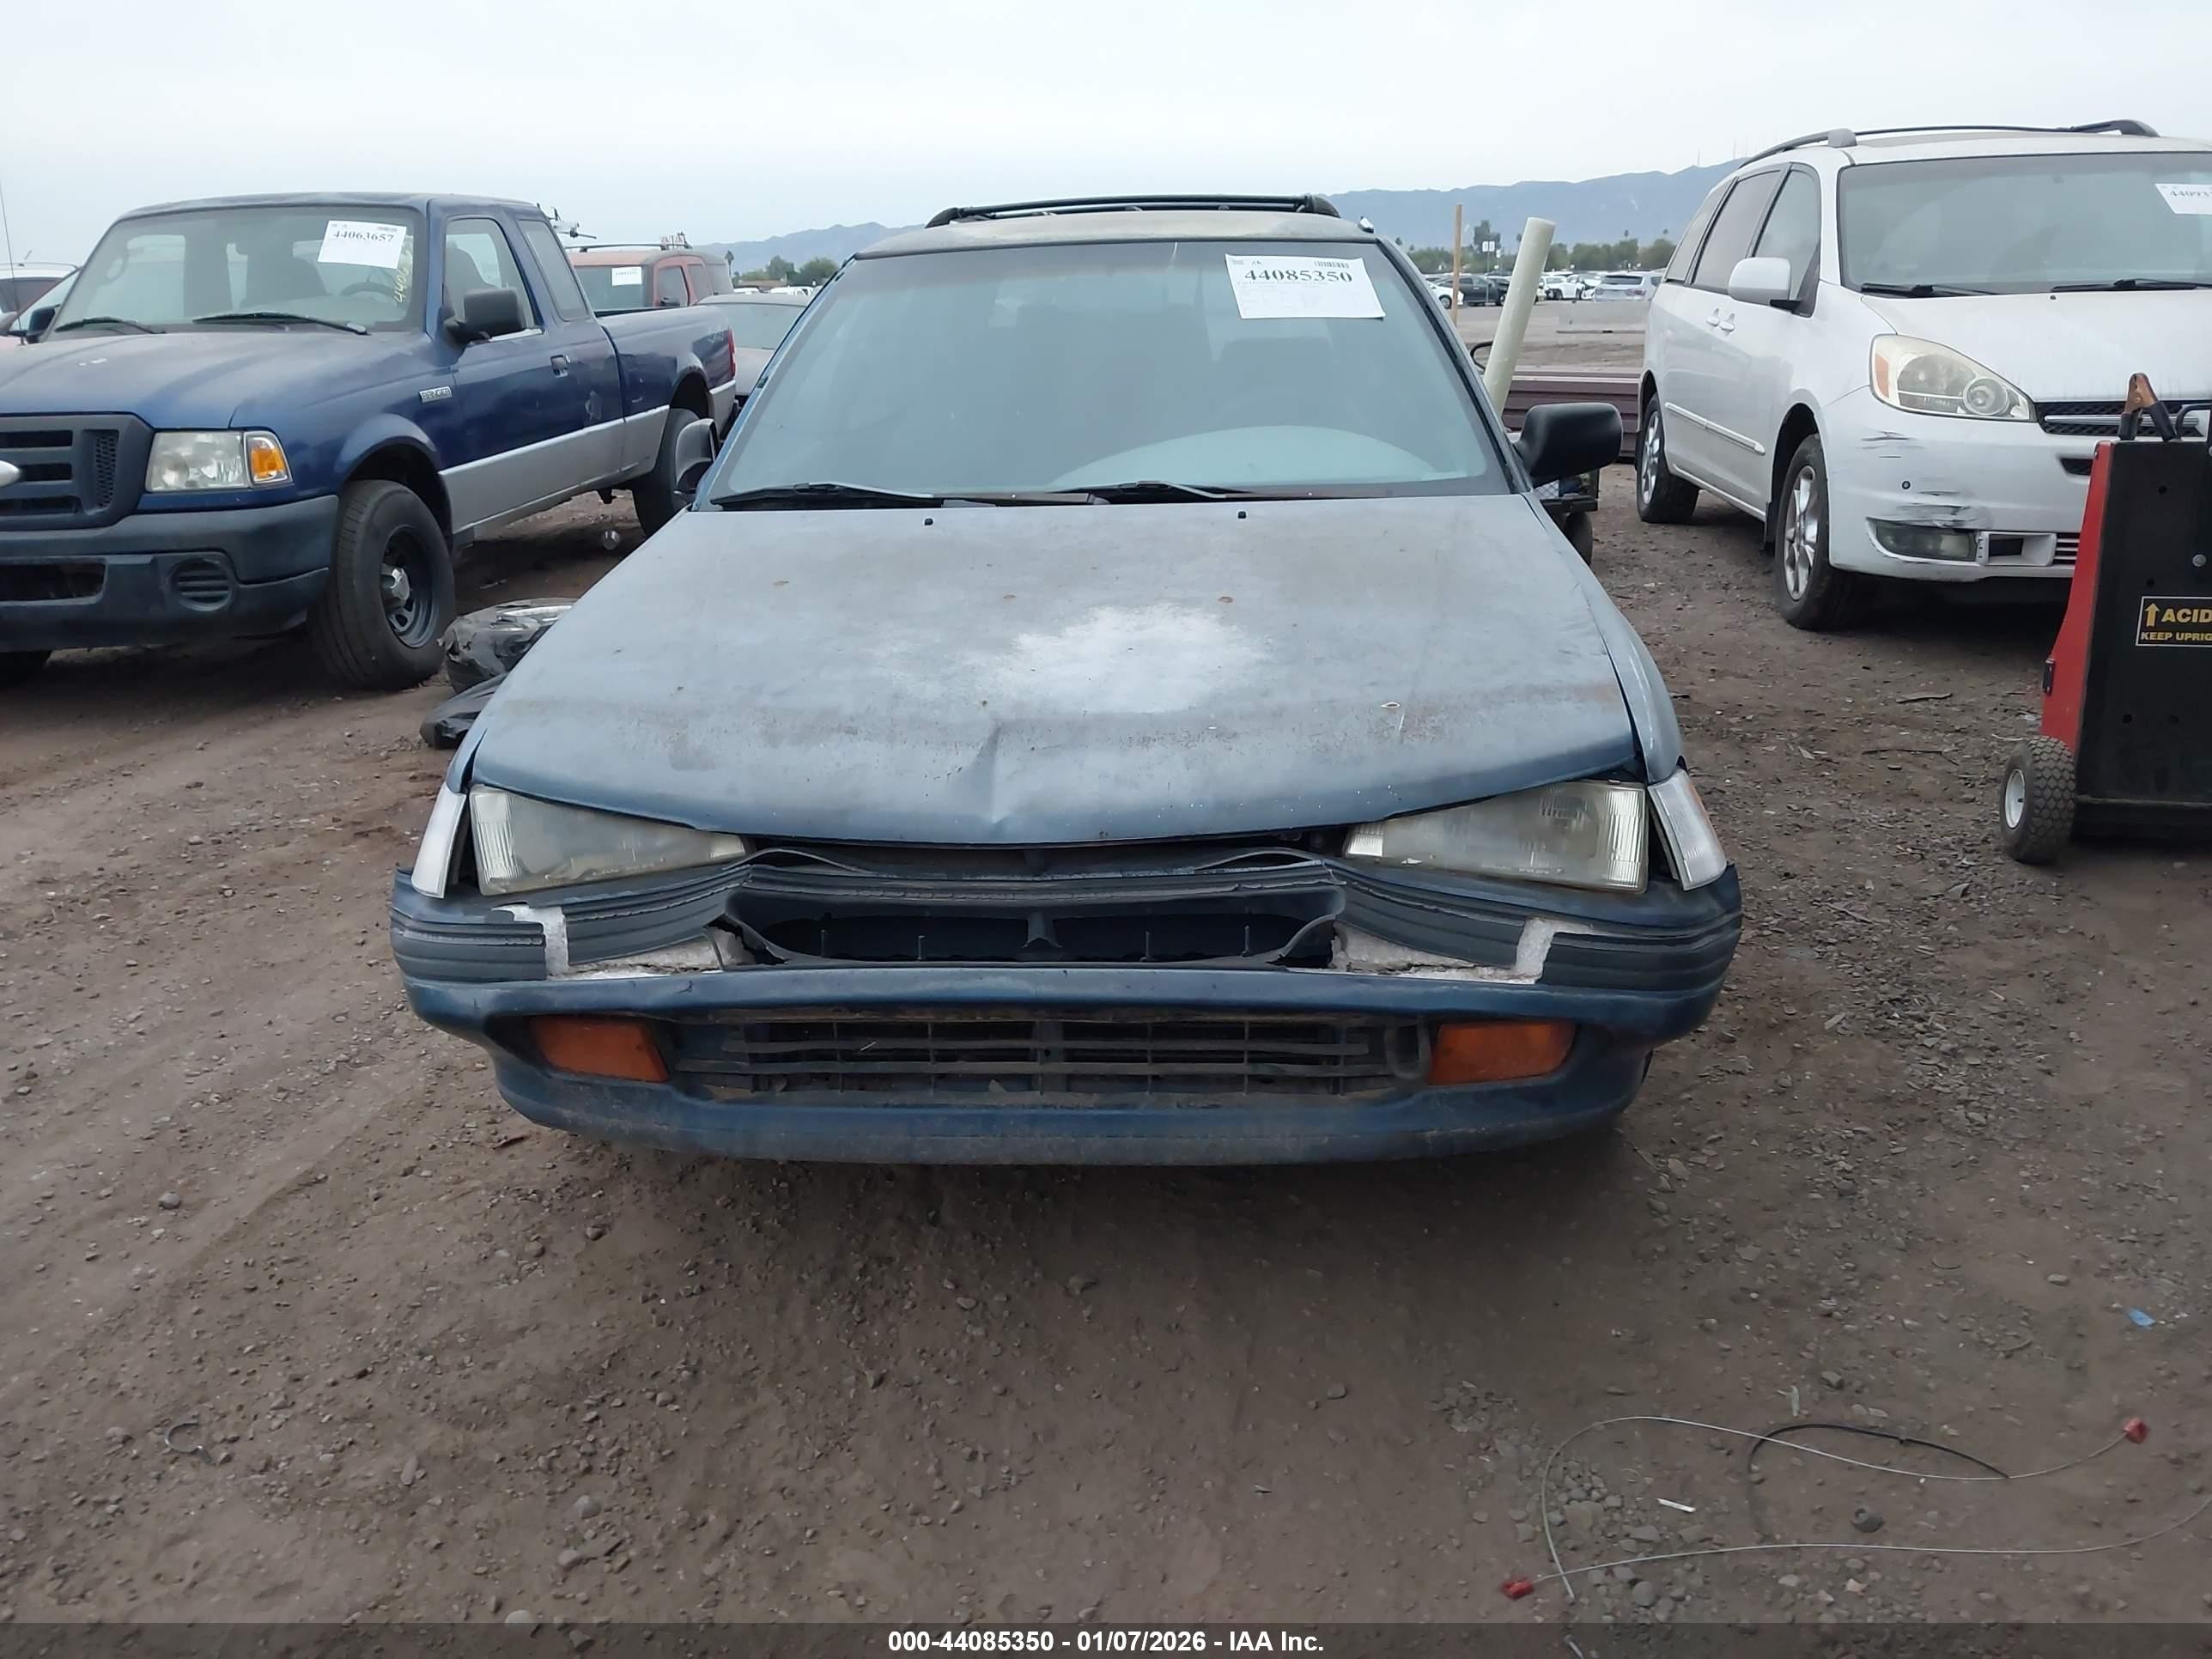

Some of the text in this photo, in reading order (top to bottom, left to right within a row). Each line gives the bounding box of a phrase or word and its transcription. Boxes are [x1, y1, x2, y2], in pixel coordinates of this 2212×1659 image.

[333, 230, 394, 242] 44063657
[1244, 269, 1352, 283] 44085350
[2161, 608, 2212, 623] ACID
[2141, 631, 2172, 640] KEEP
